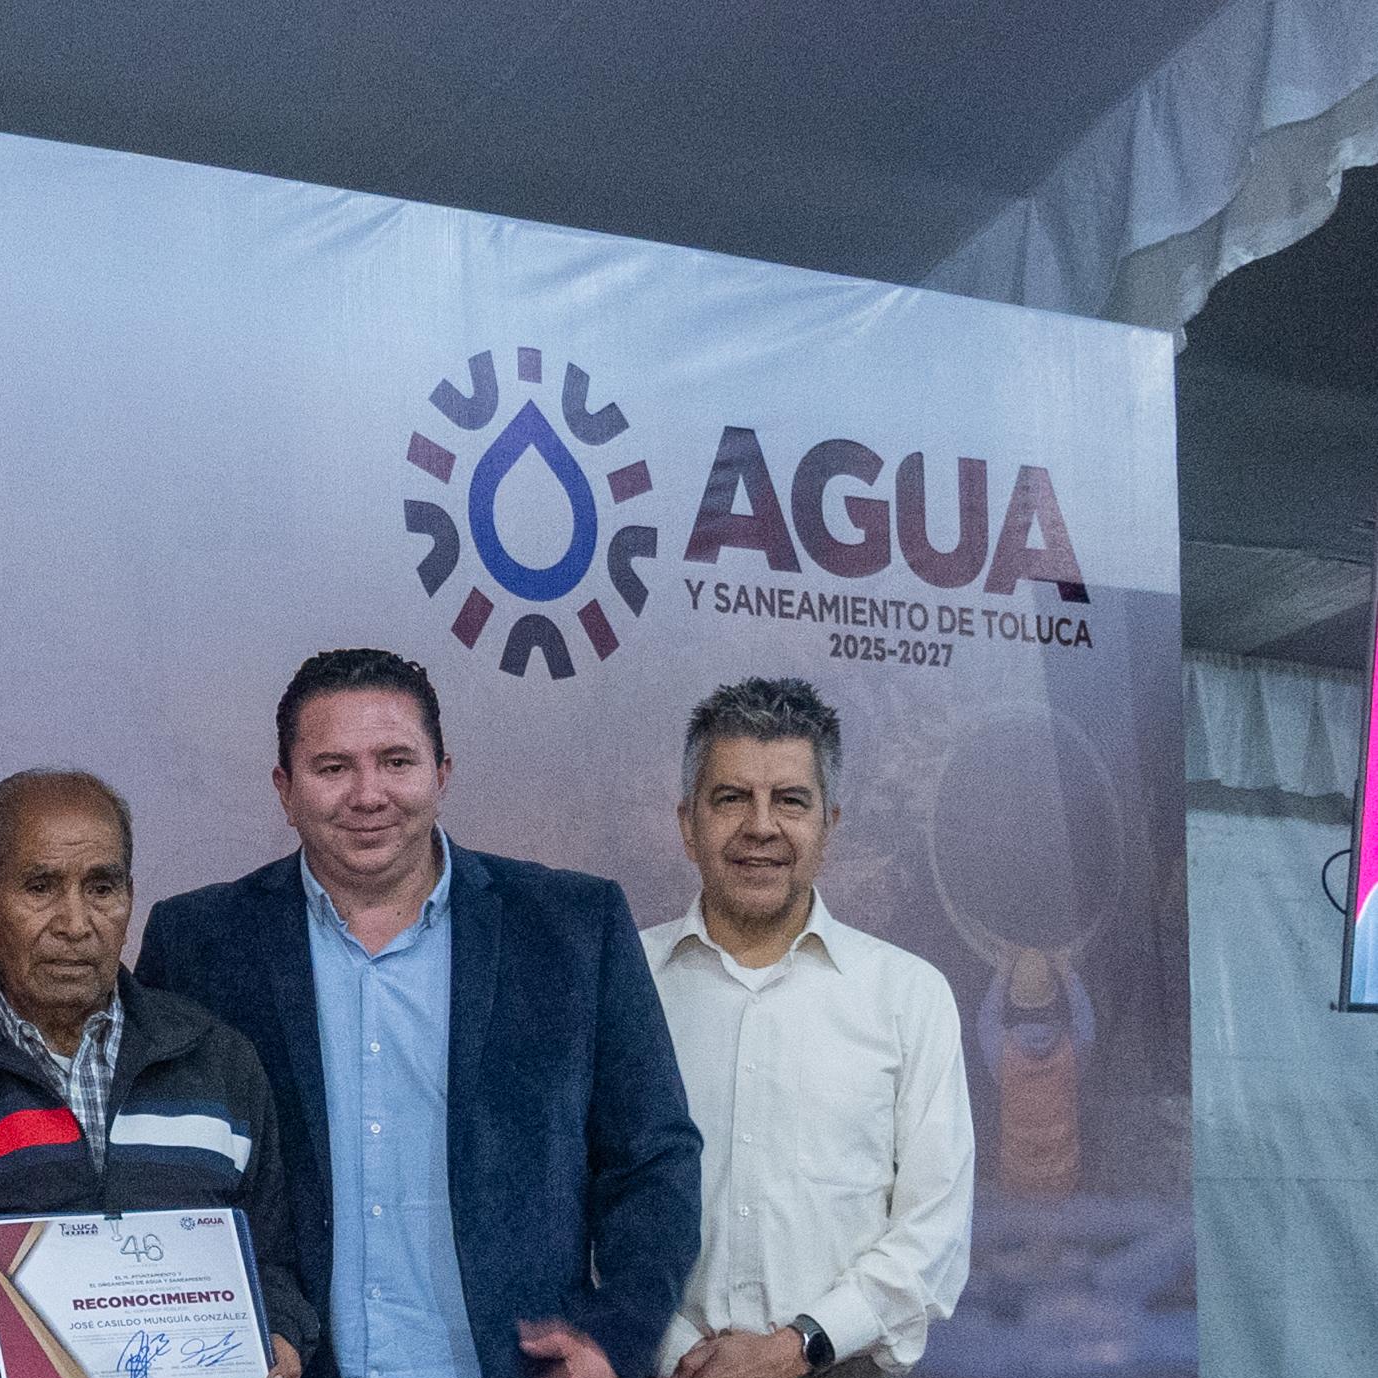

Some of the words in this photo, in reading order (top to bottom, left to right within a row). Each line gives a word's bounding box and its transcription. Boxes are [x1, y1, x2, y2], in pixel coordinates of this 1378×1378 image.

[683, 425, 1091, 604] AGUA
[684, 578, 705, 609] Y
[714, 582, 928, 632] SANEAMIENTO
[938, 606, 975, 637] DE
[981, 609, 1094, 649] TOLUCA
[829, 633, 953, 667] 2025-2027
[197, 1217, 225, 1225] AGUA
[120, 1233, 164, 1263] 46
[72, 1289, 235, 1311] RECONOCIMIENTO
[69, 1319, 94, 1330] JOSÉ
[97, 1317, 141, 1329] CASILDO
[143, 1313, 191, 1325] MUNGUÍA
[193, 1311, 248, 1322] GONZÁLEZ
